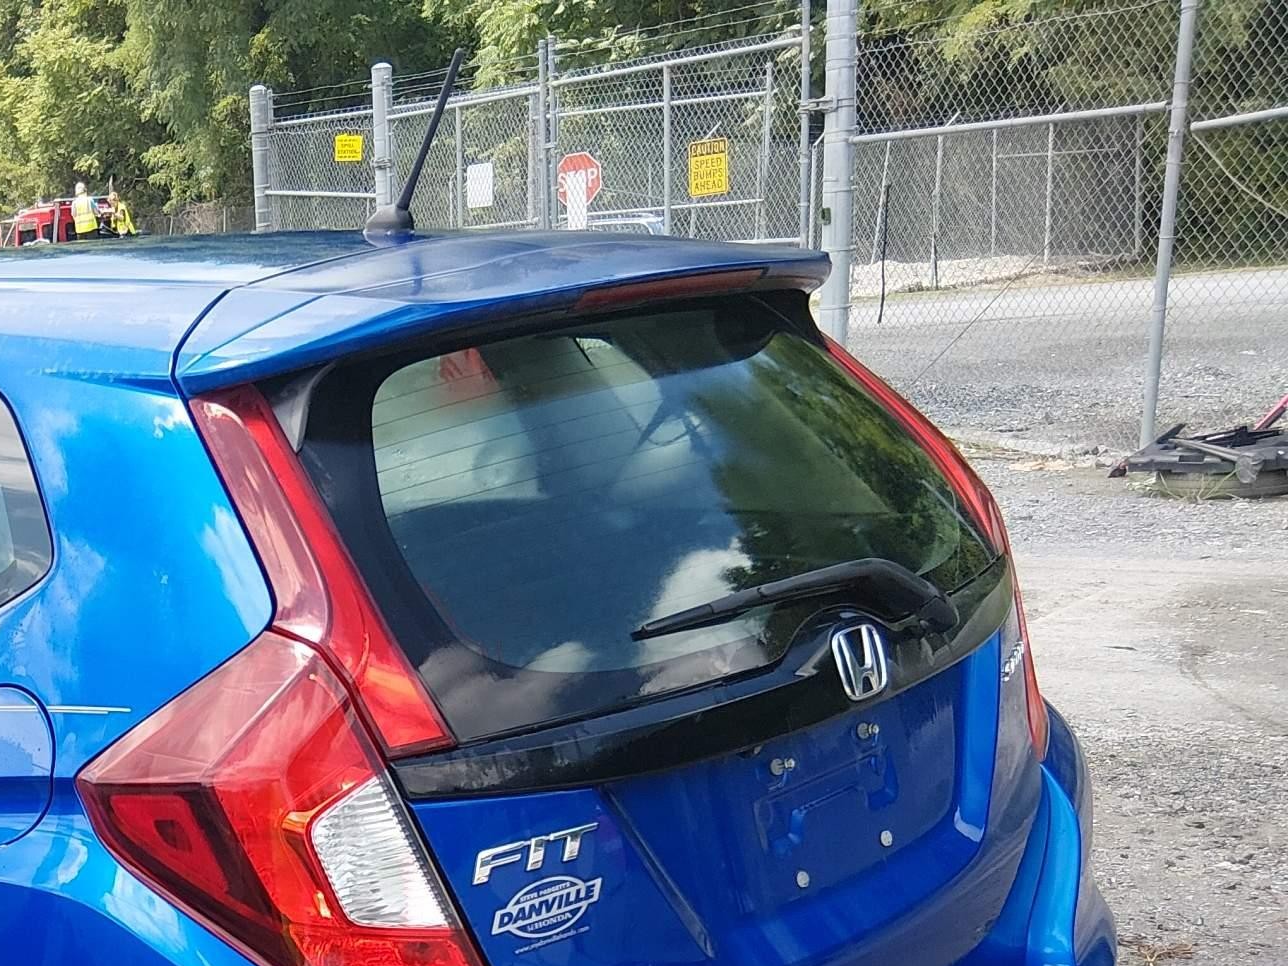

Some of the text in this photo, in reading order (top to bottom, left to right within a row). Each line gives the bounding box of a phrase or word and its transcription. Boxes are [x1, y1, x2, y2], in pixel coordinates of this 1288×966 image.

[691, 141, 725, 155] CAUTION
[694, 157, 722, 170] SPEED
[693, 168, 723, 181] BUMPS
[694, 179, 723, 192] AHEAD
[472, 822, 599, 885] FIT
[498, 884, 596, 928] DANVILLE
[535, 912, 573, 930] HONDA
